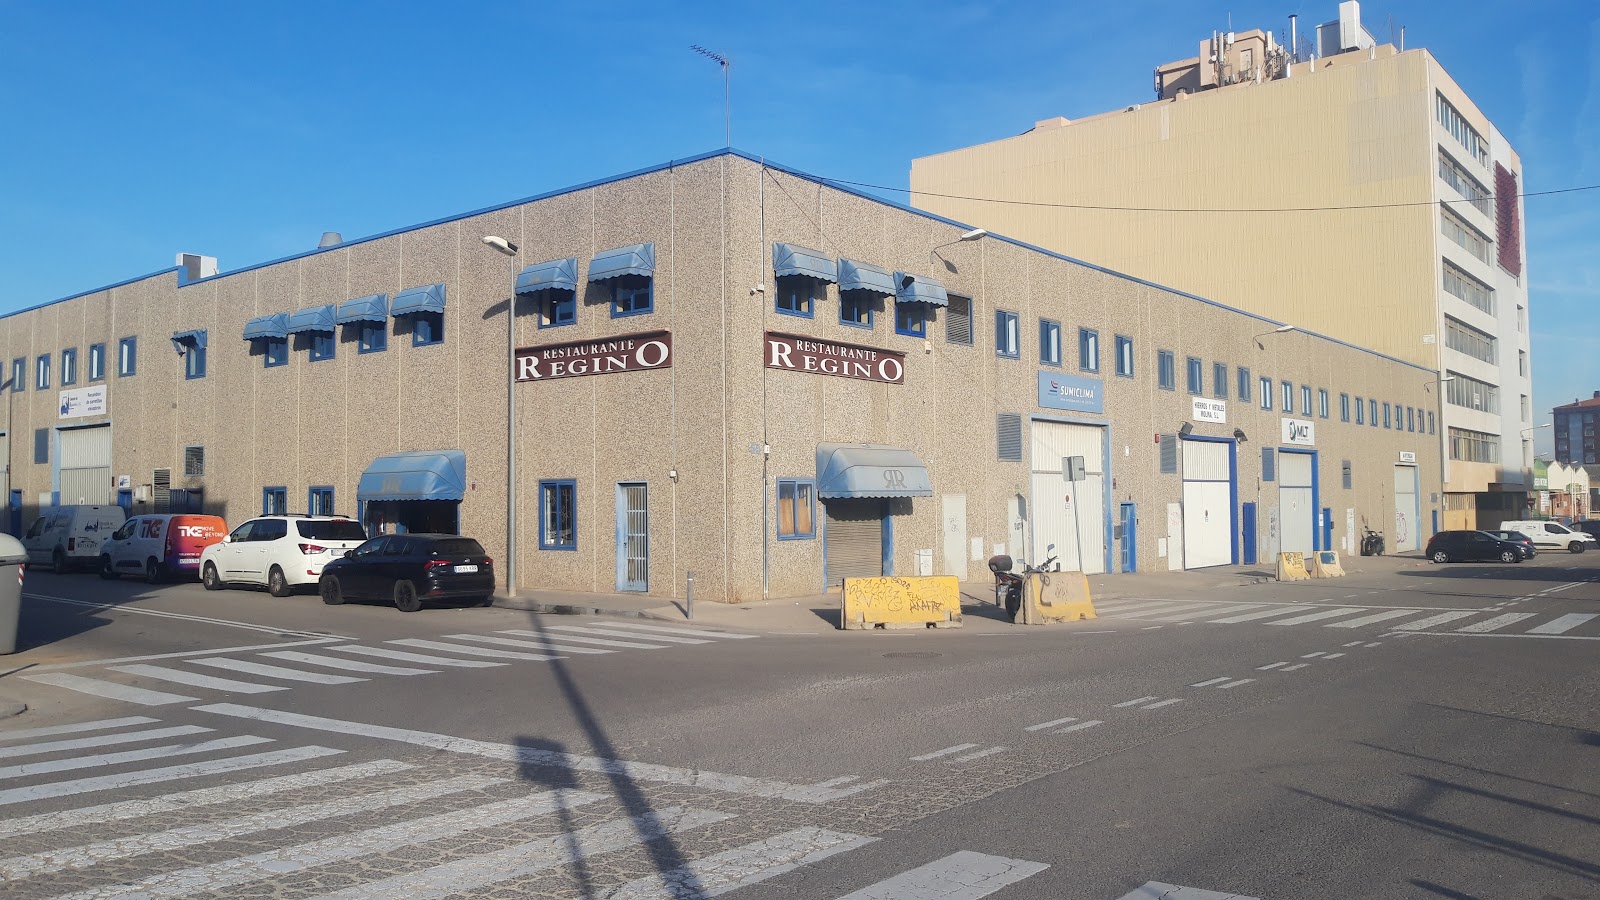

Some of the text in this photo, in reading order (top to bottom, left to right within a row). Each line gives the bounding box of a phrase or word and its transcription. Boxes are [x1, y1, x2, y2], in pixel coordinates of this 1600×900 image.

[543, 340, 635, 359] RESTAURANTE
[796, 340, 877, 362] RESTAURANTE
[516, 341, 669, 380] REGINO
[768, 340, 903, 381] REGINO
[1060, 385, 1094, 399] SUMICLIMA
[1296, 425, 1309, 438] MLT
[142, 520, 163, 538] TKE
[178, 526, 202, 537] TKE
